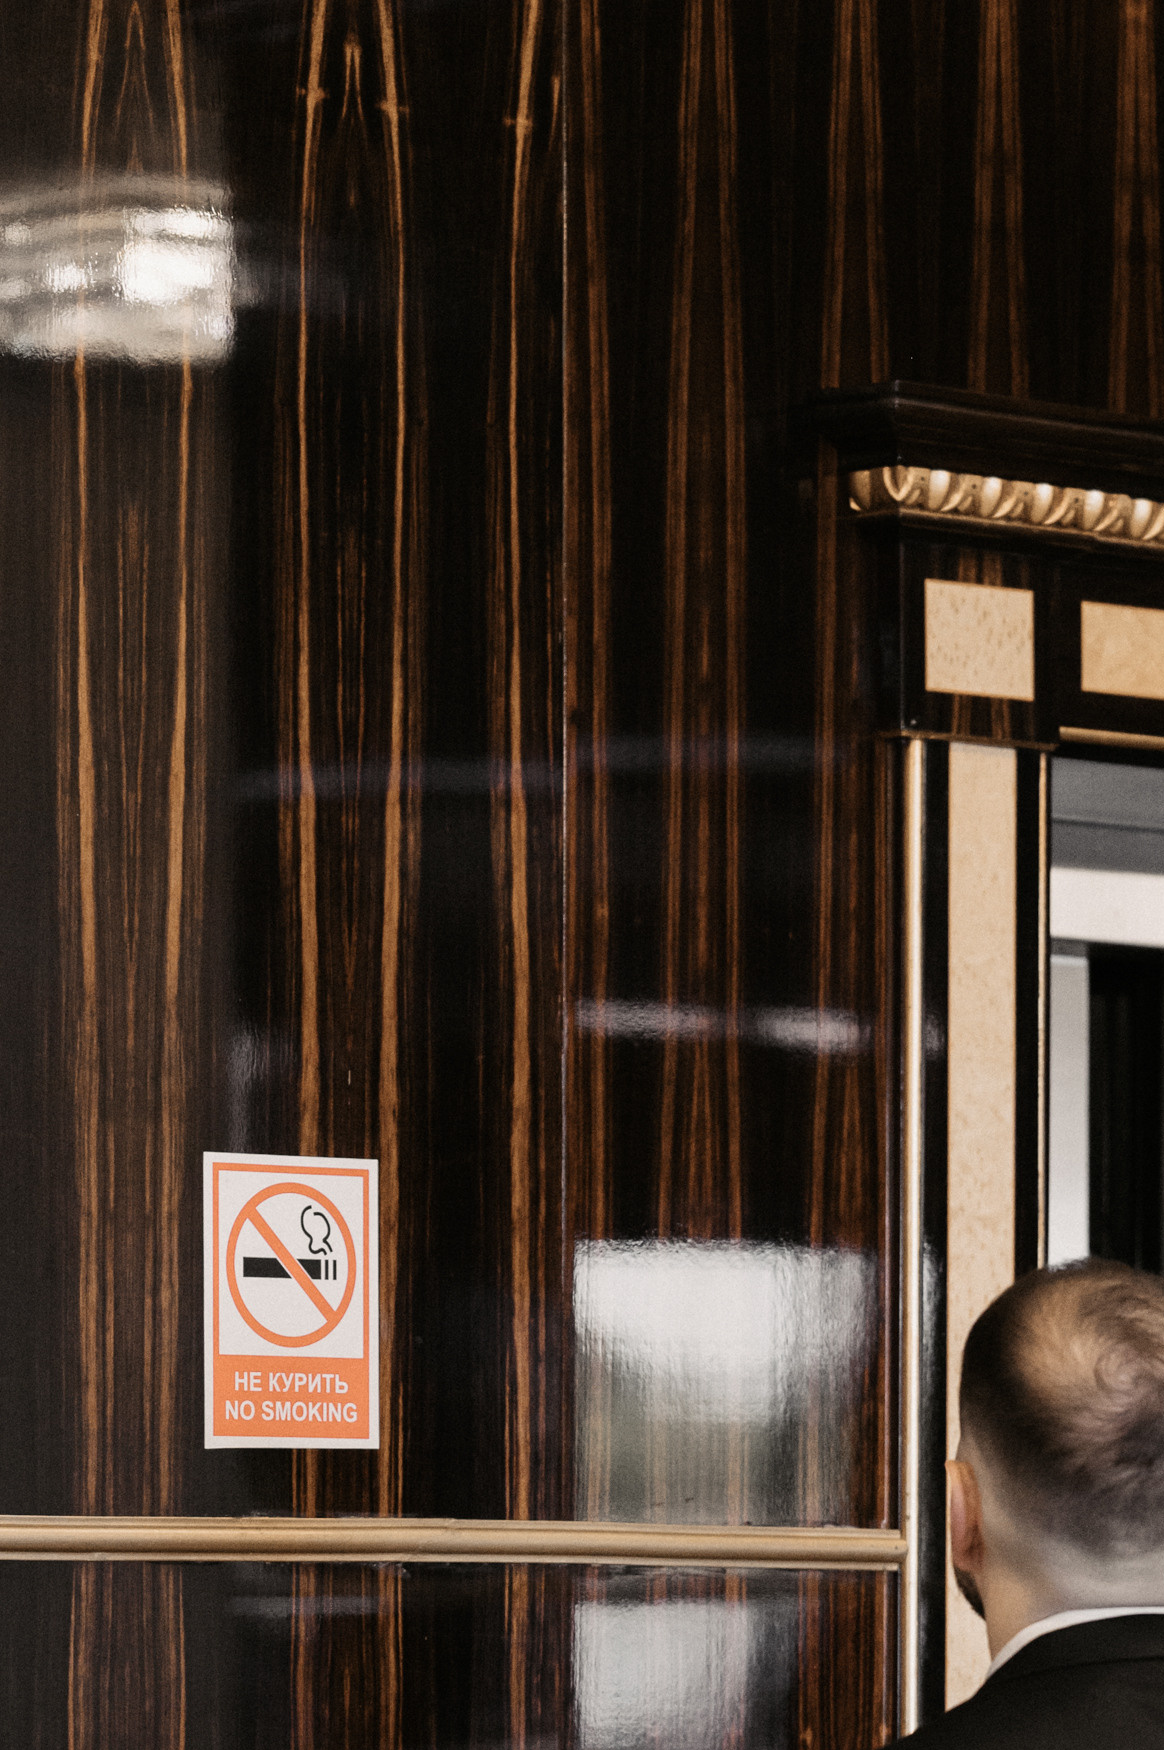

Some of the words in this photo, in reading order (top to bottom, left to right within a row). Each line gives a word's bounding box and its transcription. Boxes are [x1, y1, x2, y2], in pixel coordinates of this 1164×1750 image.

[234, 1371, 263, 1392] НЕ
[268, 1372, 349, 1394] КУРИТЬ
[225, 1400, 256, 1421] NO
[261, 1401, 358, 1423] SMOKING
